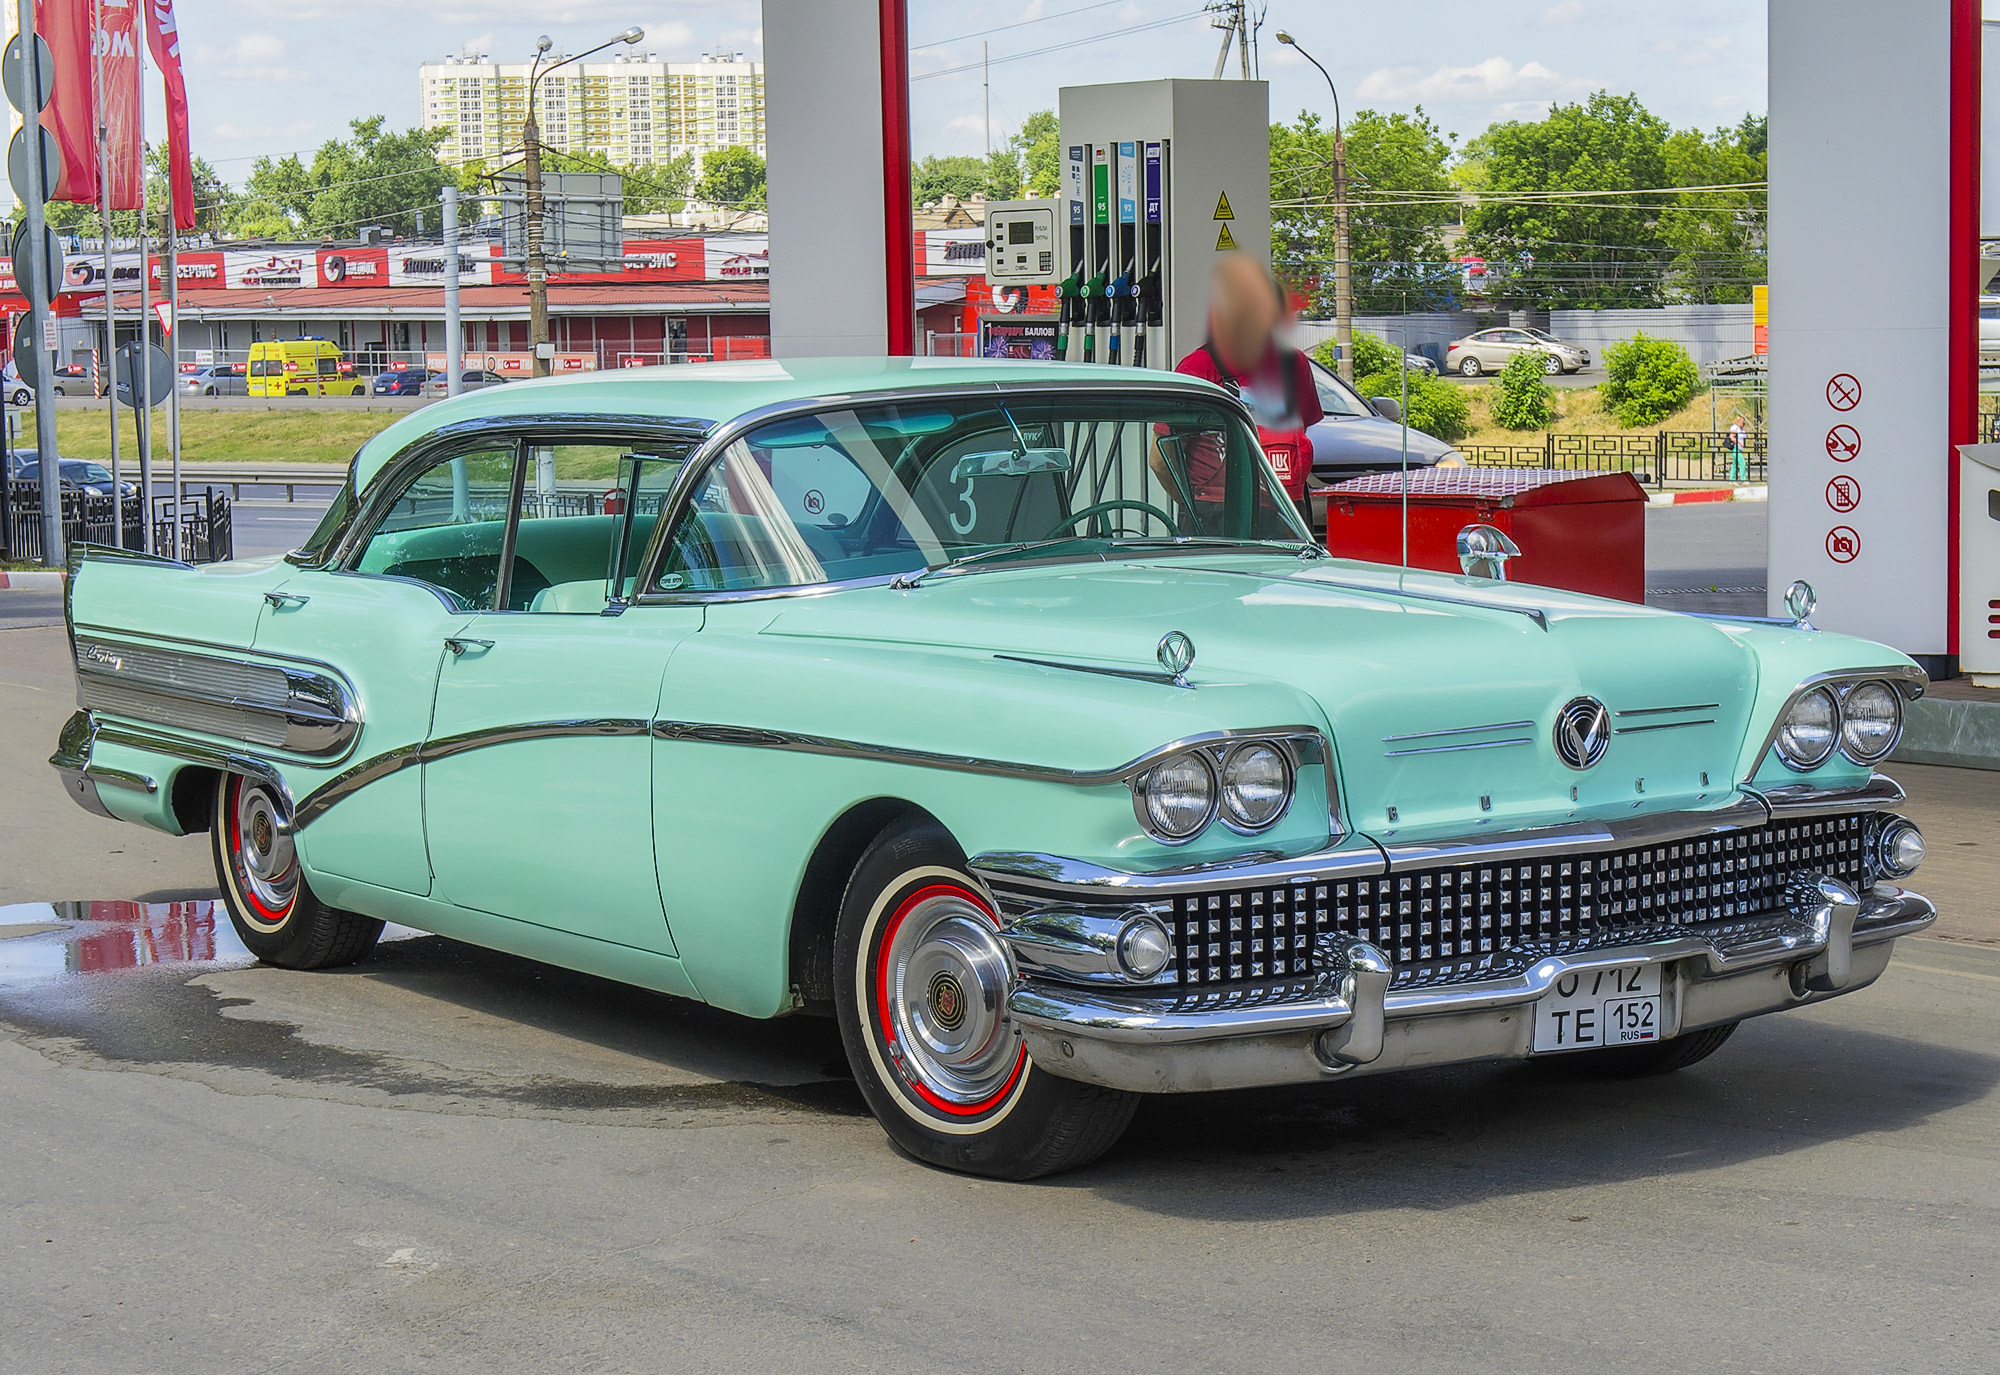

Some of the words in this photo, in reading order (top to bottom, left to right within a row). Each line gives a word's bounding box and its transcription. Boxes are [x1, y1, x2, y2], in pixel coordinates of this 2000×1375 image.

[1073, 206, 1081, 214] 95
[1097, 203, 1106, 212] 95
[1123, 204, 1132, 212] 92
[1149, 203, 1159, 213] ДТ
[1024, 326, 1055, 337] БАЛЛОВ!
[949, 464, 977, 535] 3
[1612, 1001, 1654, 1030] 152
[1551, 1008, 1595, 1045] ТЕ
[1620, 1030, 1640, 1041] RUS
